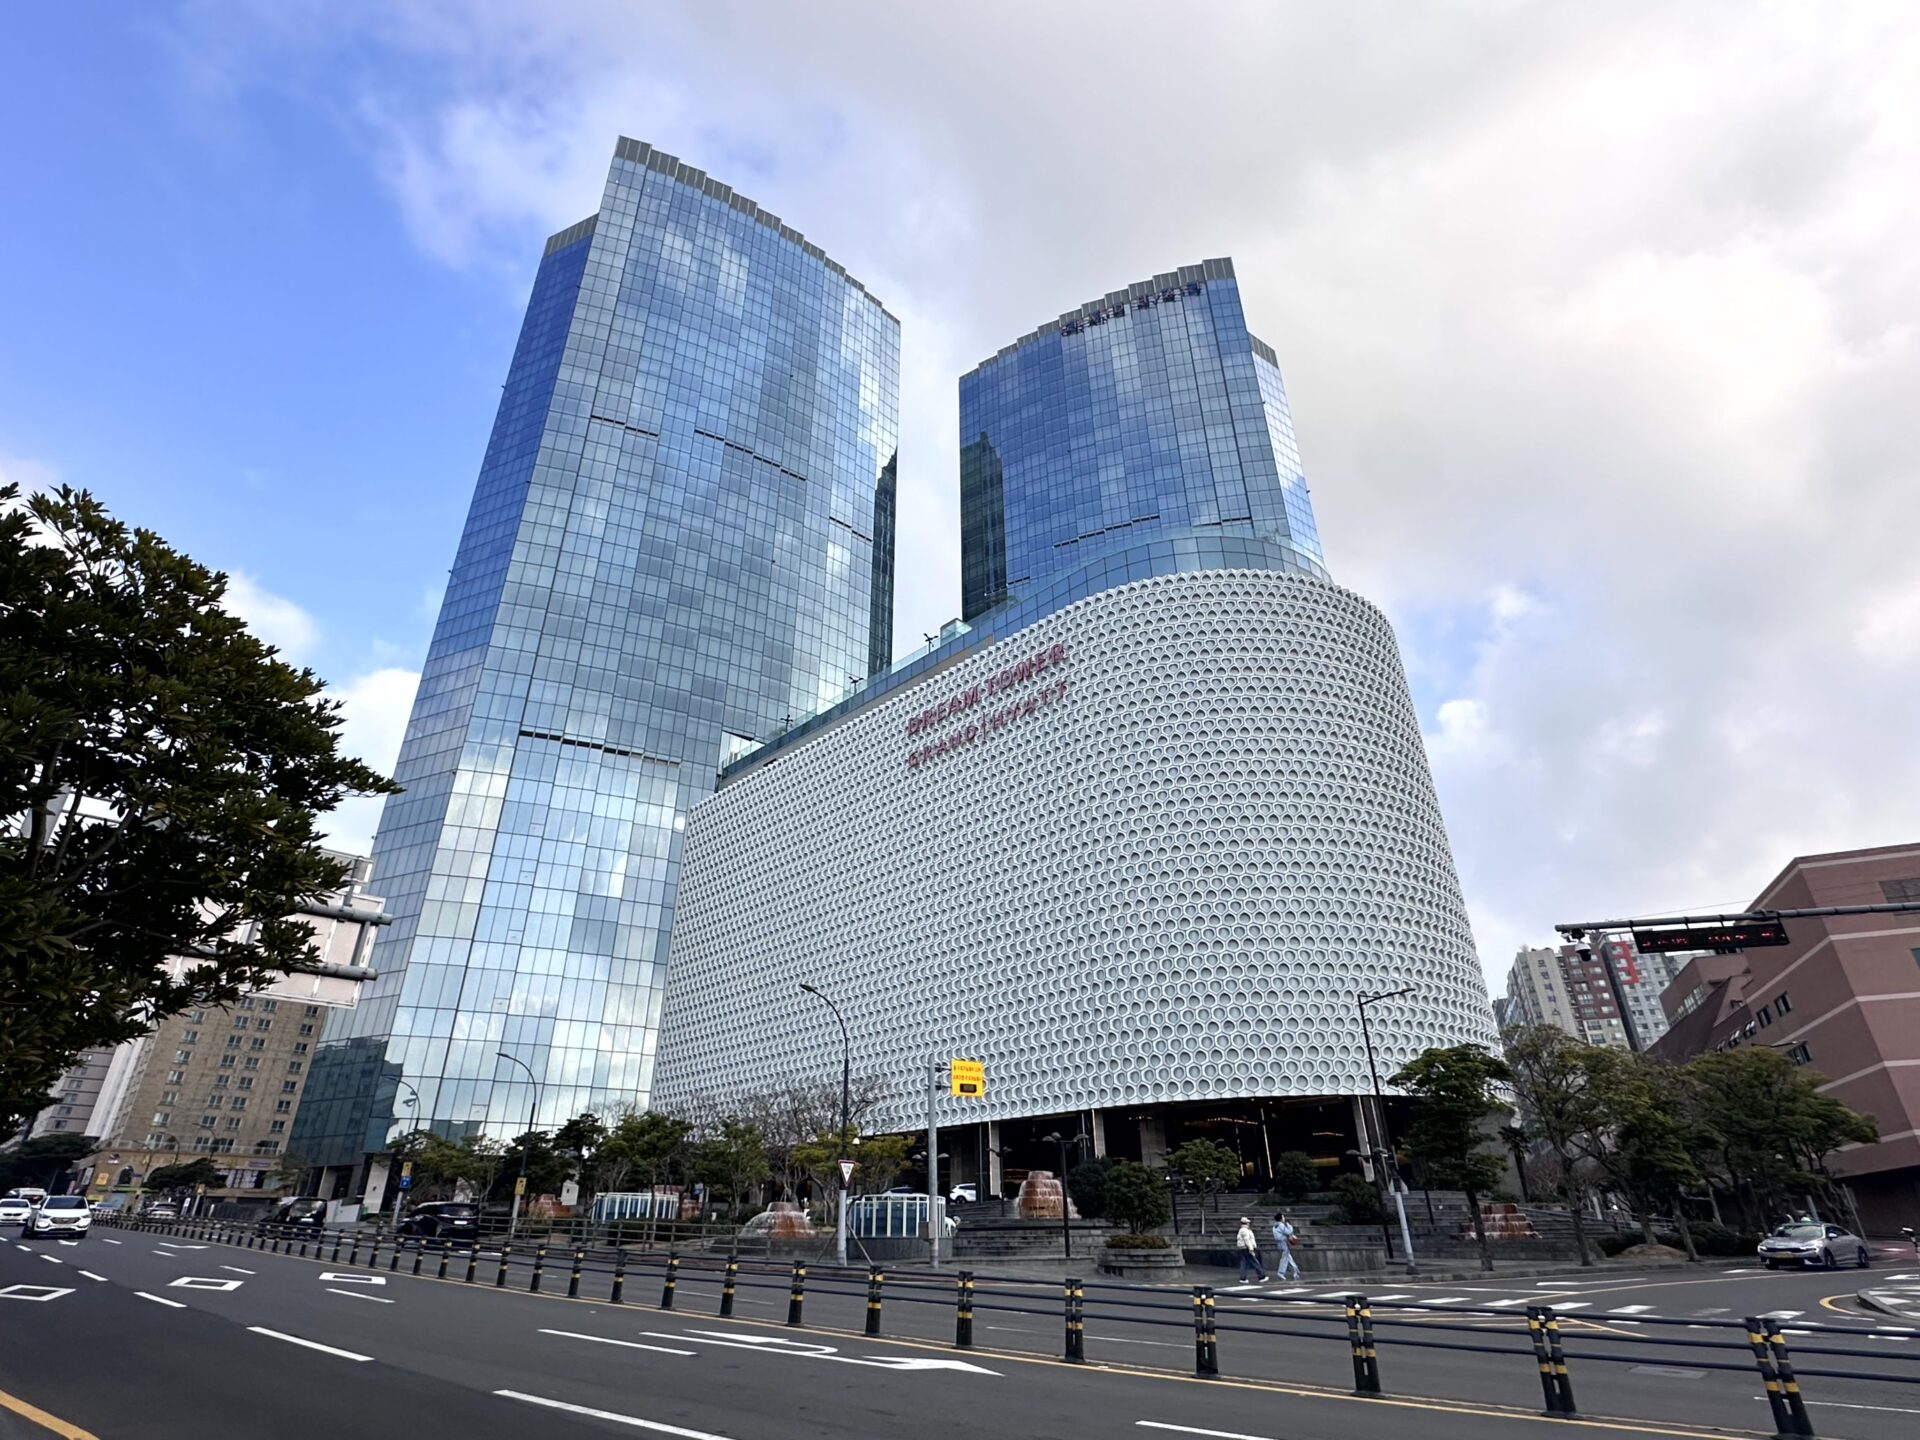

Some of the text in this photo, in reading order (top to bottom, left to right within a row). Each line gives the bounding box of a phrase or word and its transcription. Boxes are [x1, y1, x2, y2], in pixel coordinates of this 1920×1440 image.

[905, 643, 1068, 736] DREAM TOWER
[906, 679, 1068, 769] GRAND HYATT
